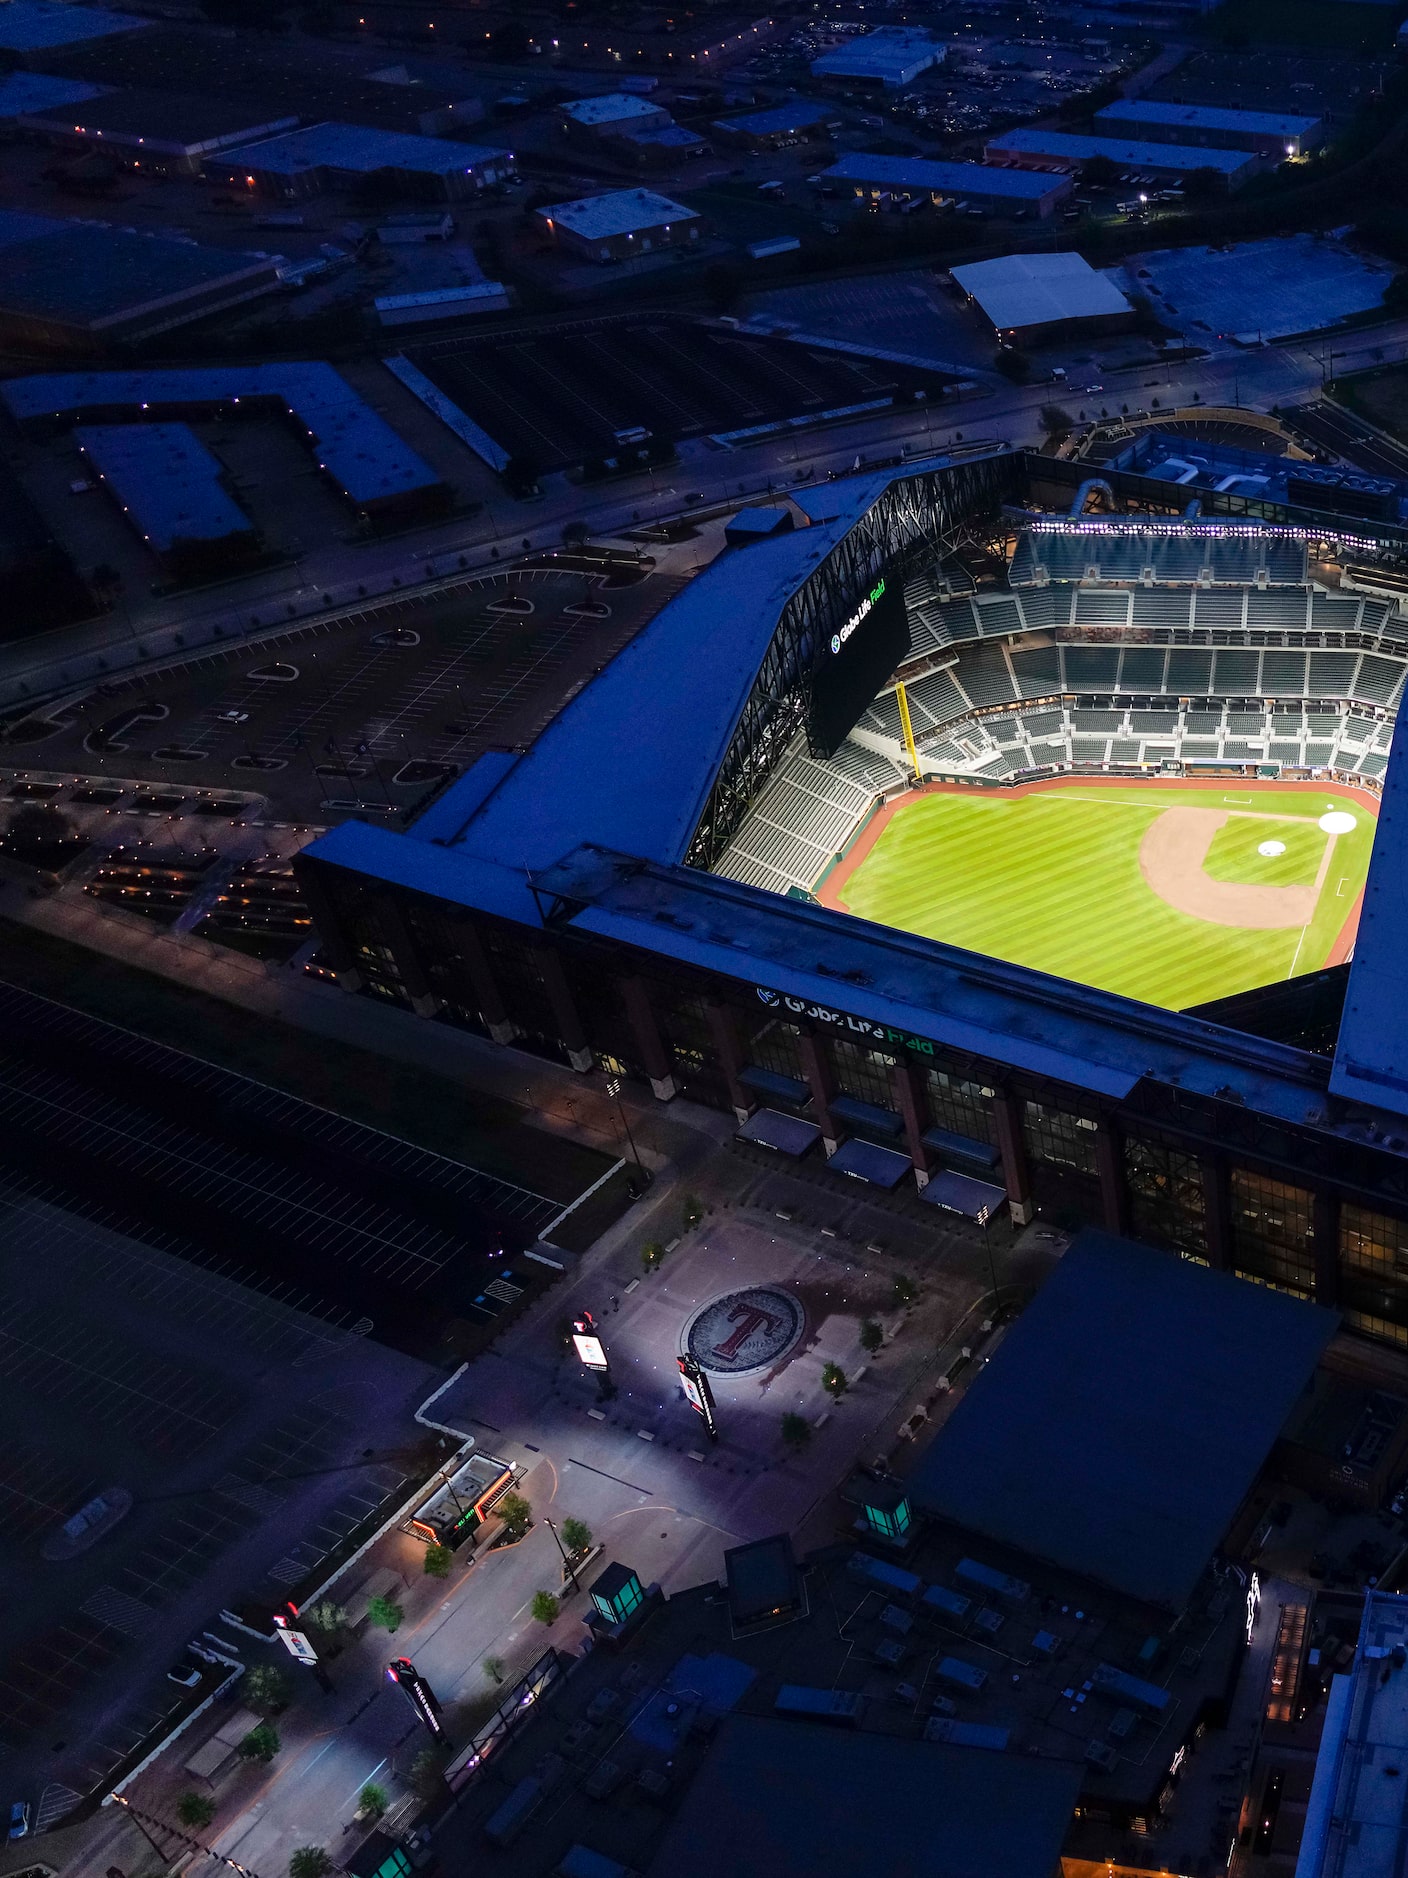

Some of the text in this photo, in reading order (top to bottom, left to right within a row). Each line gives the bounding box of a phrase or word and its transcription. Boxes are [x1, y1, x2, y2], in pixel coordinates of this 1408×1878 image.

[840, 578, 886, 643] Globe Life Field
